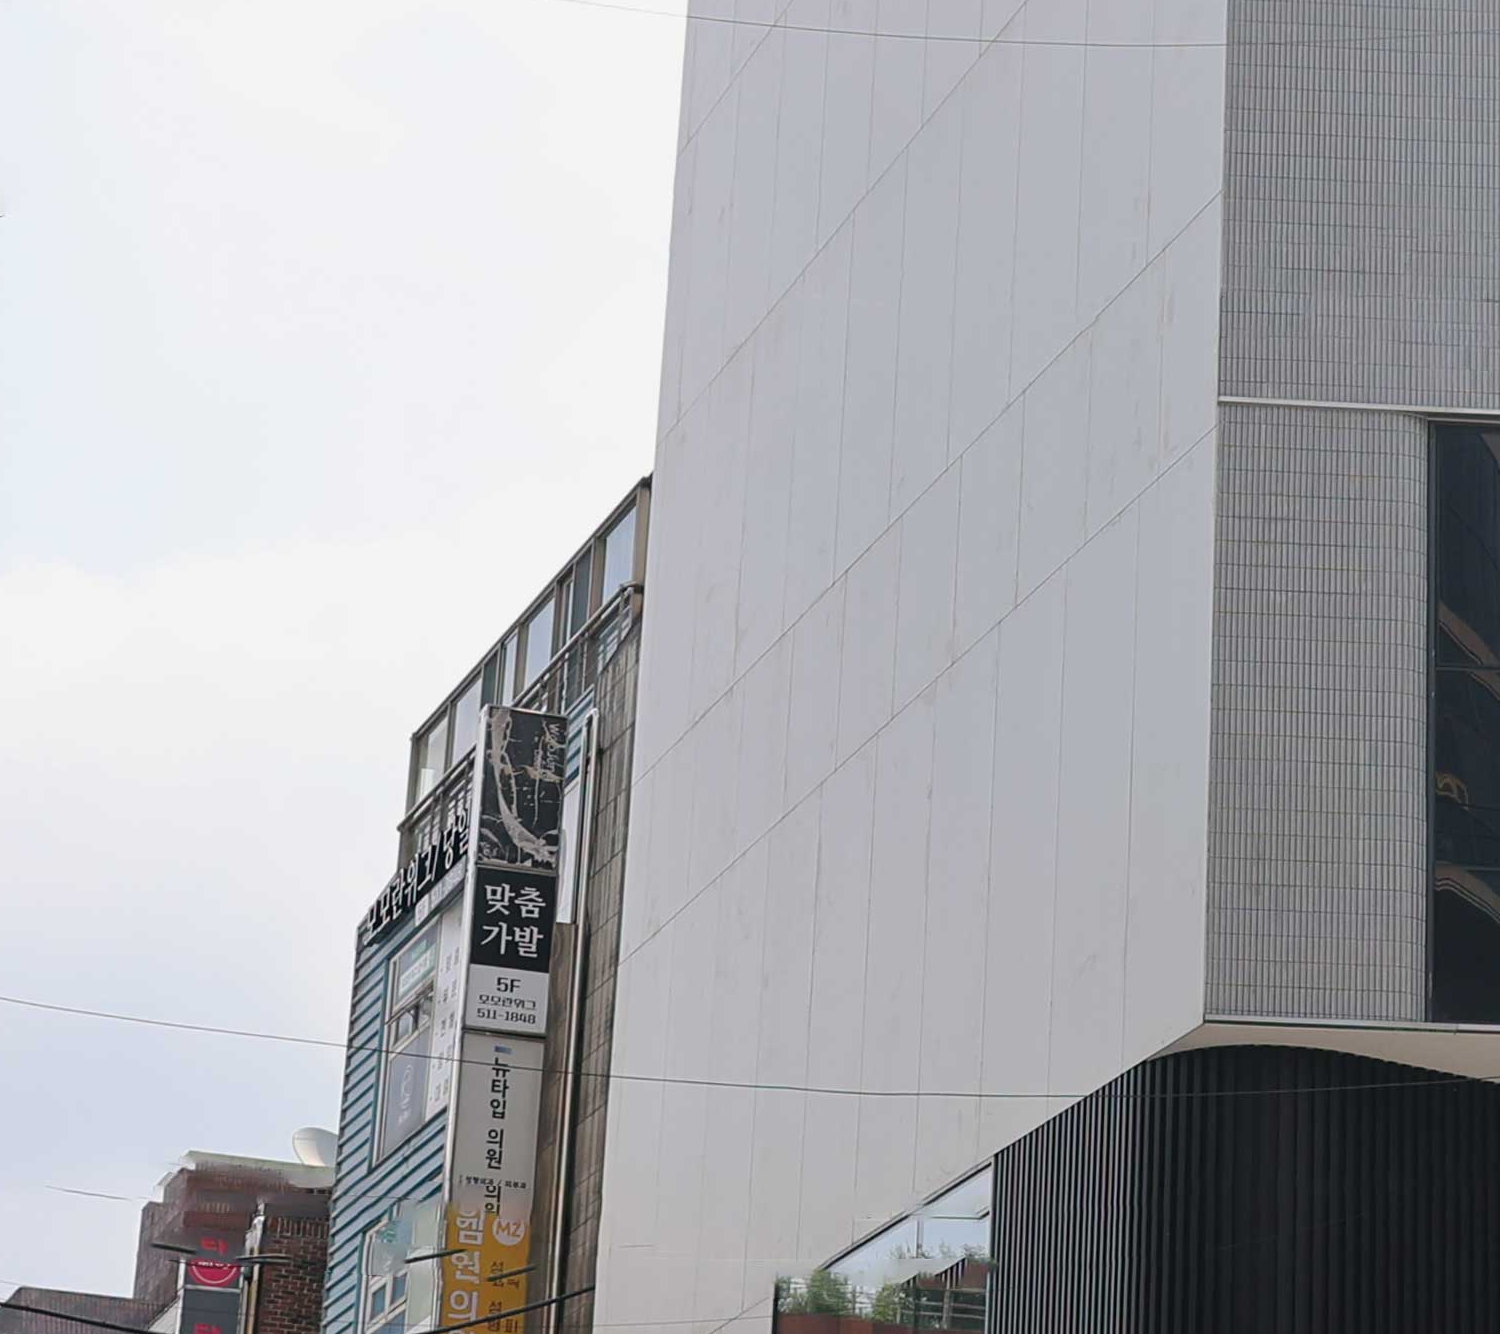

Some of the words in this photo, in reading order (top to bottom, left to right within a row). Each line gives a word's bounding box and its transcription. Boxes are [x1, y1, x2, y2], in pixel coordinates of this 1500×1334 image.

[485, 884, 546, 919] 맞춤
[480, 921, 543, 958] 가발
[497, 977, 521, 993] 5F
[477, 1009, 536, 1025] 511-1848
[487, 1128, 505, 1170] 의원
